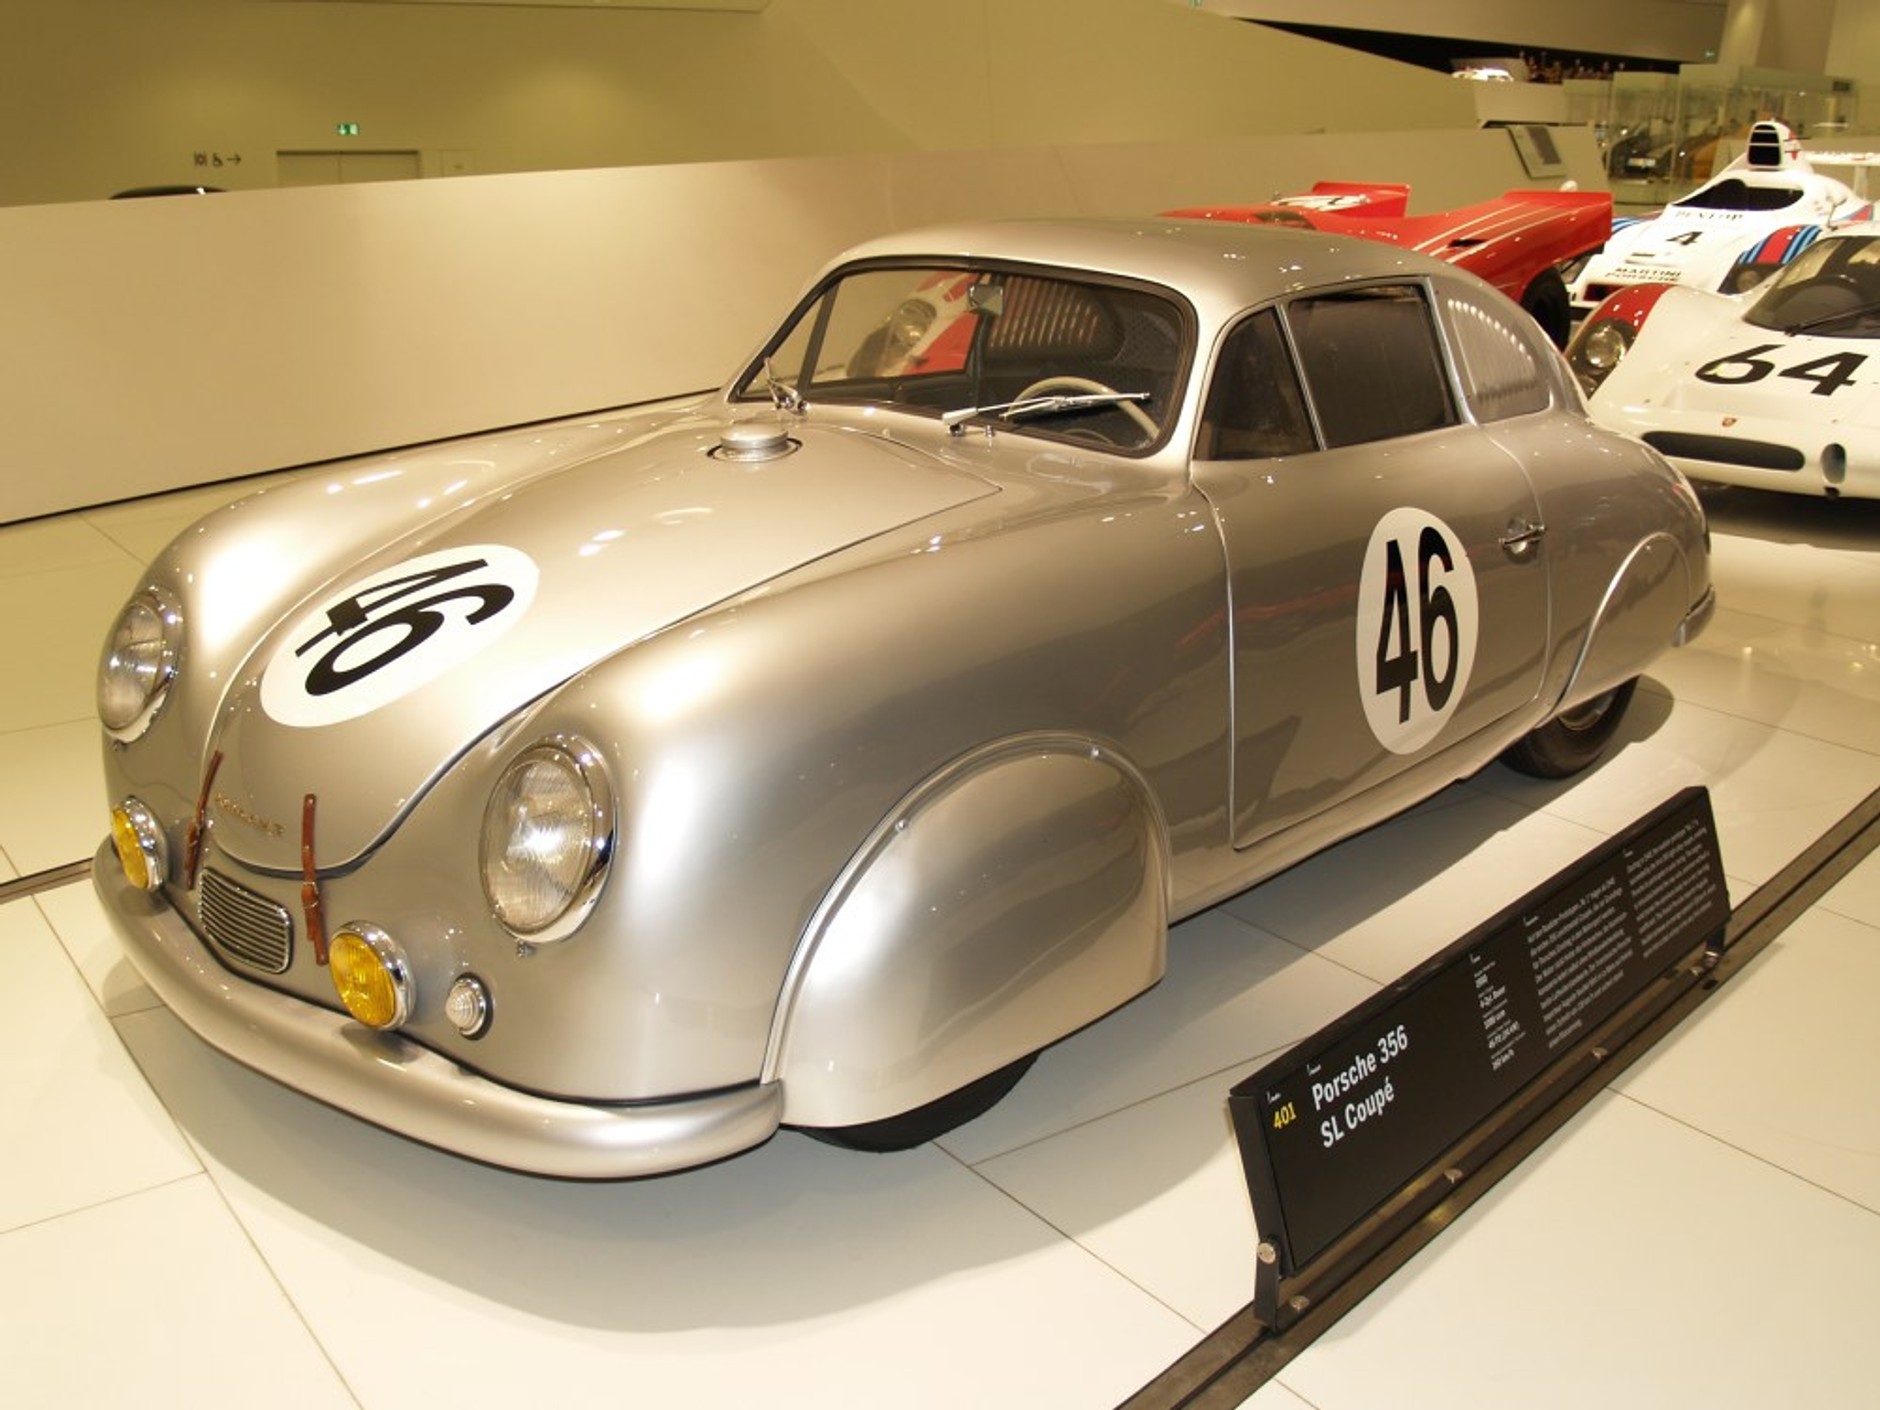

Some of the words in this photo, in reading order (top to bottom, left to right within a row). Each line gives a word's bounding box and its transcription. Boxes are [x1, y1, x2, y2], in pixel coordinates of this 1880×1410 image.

[1665, 230, 1703, 246] 4
[1615, 267, 1682, 277] MARTINI
[1694, 344, 1869, 397] 64
[294, 558, 515, 696] 46
[1376, 526, 1459, 725] 46
[1311, 1053, 1378, 1111] Porsche
[1377, 1024, 1408, 1064] 356
[1272, 1102, 1297, 1129] 401
[1320, 1115, 1345, 1148] SL
[1344, 1075, 1395, 1130] Coupé
